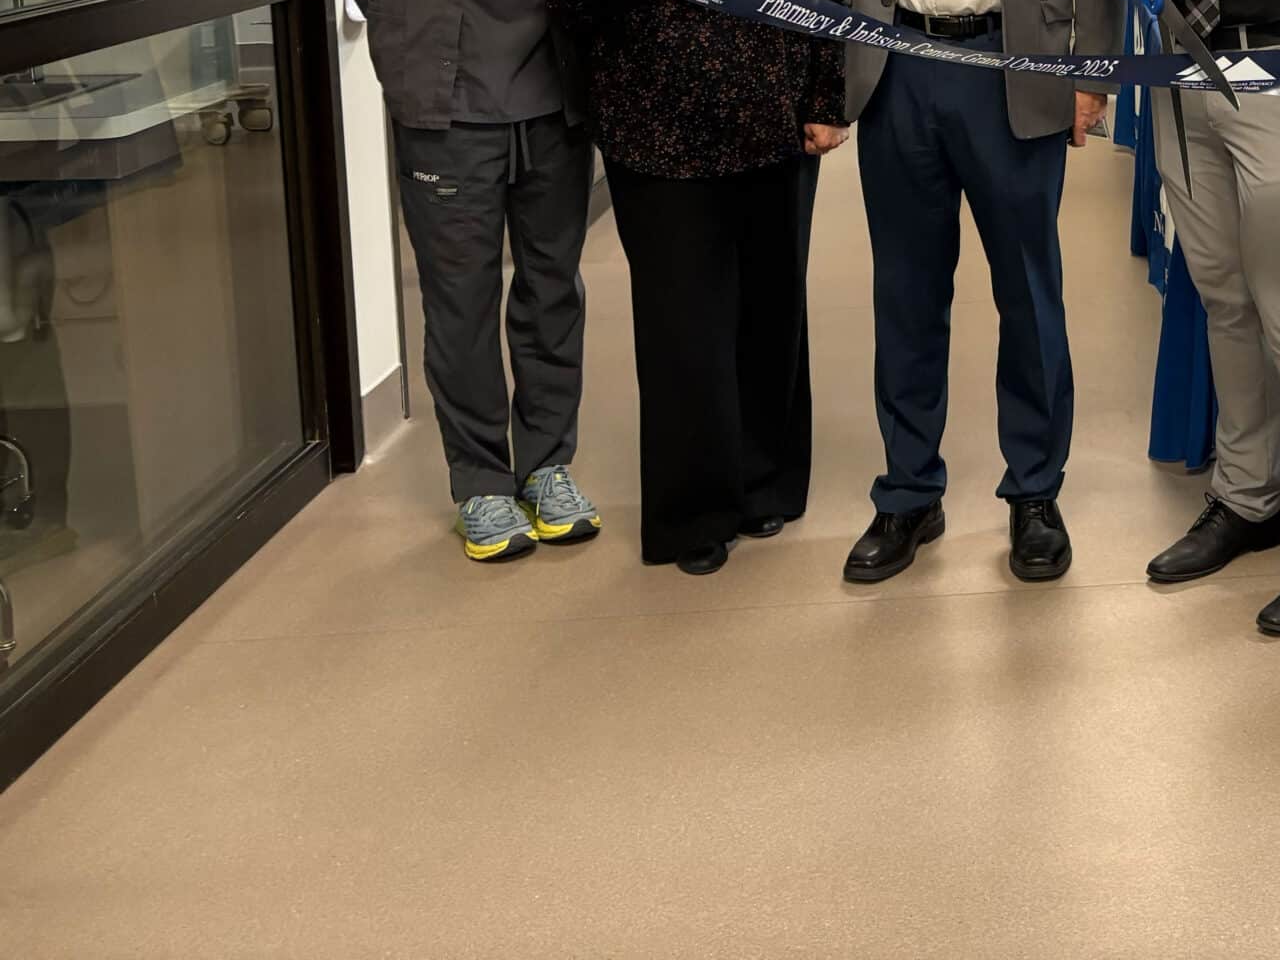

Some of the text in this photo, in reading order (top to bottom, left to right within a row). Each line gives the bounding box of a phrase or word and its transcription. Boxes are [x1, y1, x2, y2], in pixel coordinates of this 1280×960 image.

[829, 16, 853, 37] &
[847, 21, 911, 51] Infusion
[909, 42, 963, 60] Center
[961, 53, 1011, 68] Grand
[1009, 58, 1076, 76] Opening
[1072, 59, 1119, 77] 2025
